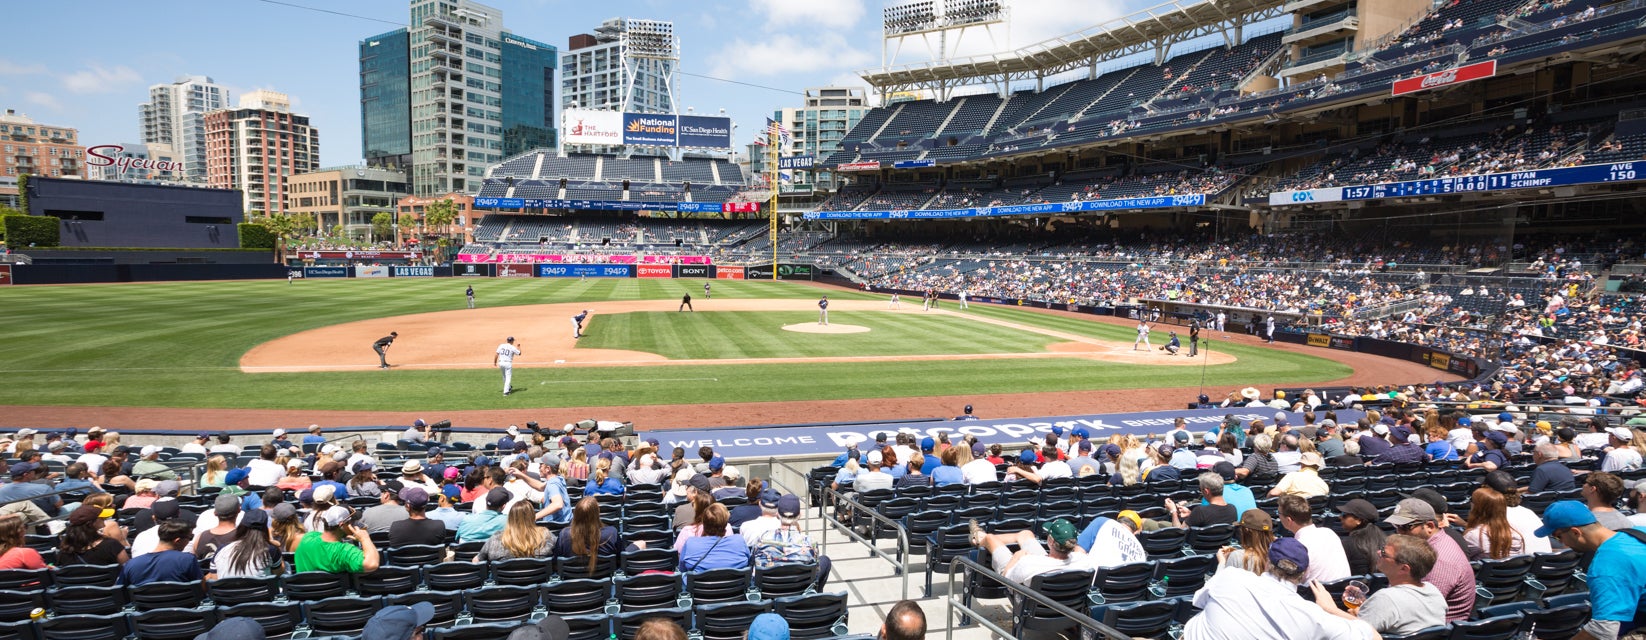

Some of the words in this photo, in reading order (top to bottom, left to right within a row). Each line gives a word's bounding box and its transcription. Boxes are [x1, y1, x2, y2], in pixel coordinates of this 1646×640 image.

[1421, 70, 1458, 88] Coca-Cola
[640, 118, 675, 126] National
[640, 126, 675, 134] Funding
[86, 145, 184, 173] Sycuan
[781, 159, 792, 168] LAS
[793, 157, 813, 167] VEGAS
[1610, 163, 1633, 171] AVG
[1491, 176, 1507, 187] 11
[1511, 172, 1537, 180] RYAN
[1604, 170, 1636, 181] .150
[1443, 184, 1450, 192] 5
[1510, 178, 1552, 188] SCHIMPF
[1292, 191, 1314, 201] COX
[1346, 188, 1370, 198] 1:57
[396, 267, 409, 276] LAS
[410, 267, 433, 276] VEGAS
[501, 348, 510, 356] 30
[669, 435, 816, 449] WELCOME
